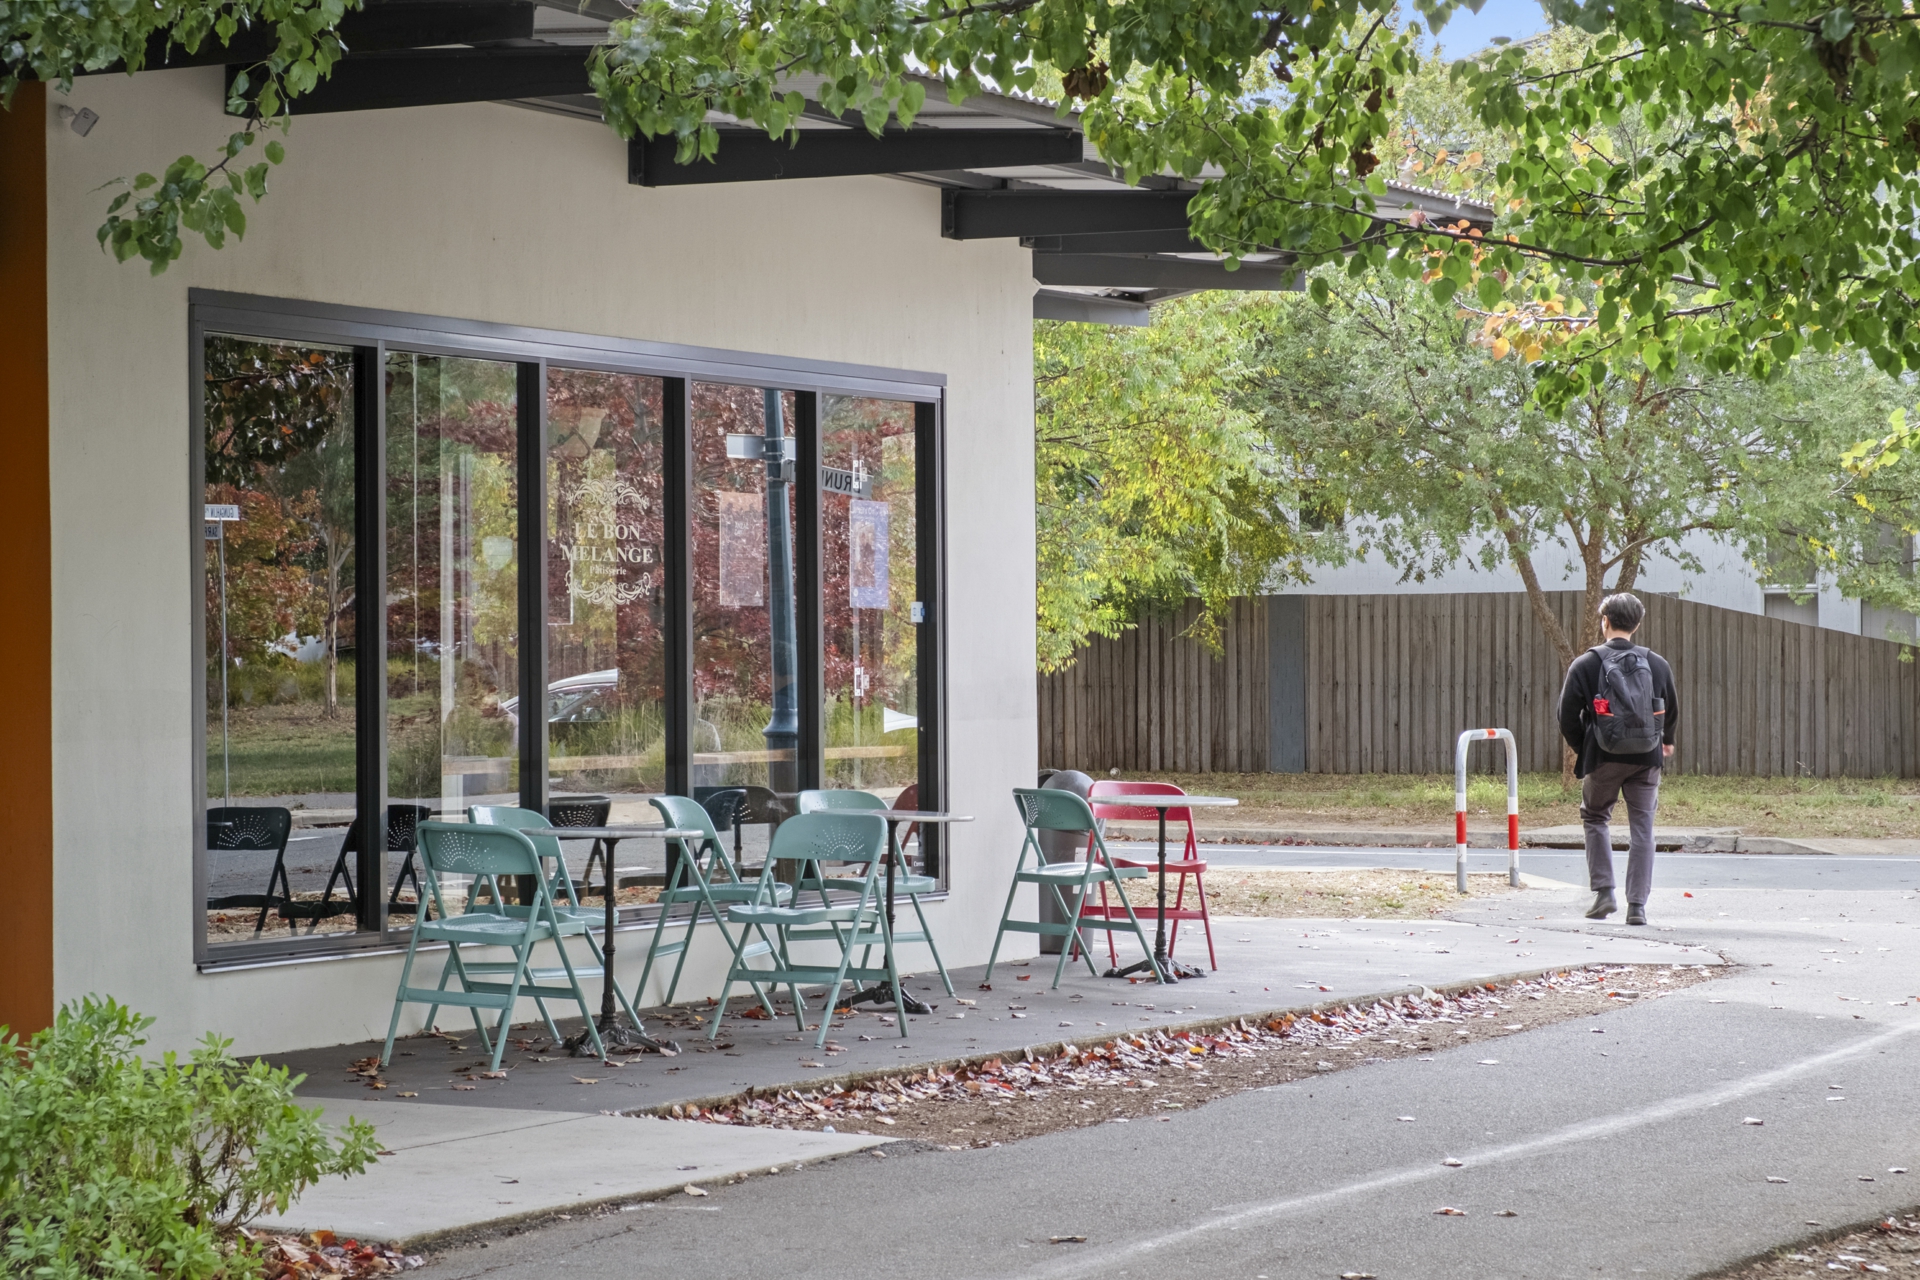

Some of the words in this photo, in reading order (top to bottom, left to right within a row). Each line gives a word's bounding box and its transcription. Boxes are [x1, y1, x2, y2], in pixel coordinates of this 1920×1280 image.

[574, 522, 598, 539] LE
[603, 523, 640, 541] BON
[561, 545, 653, 563] MELANGE
